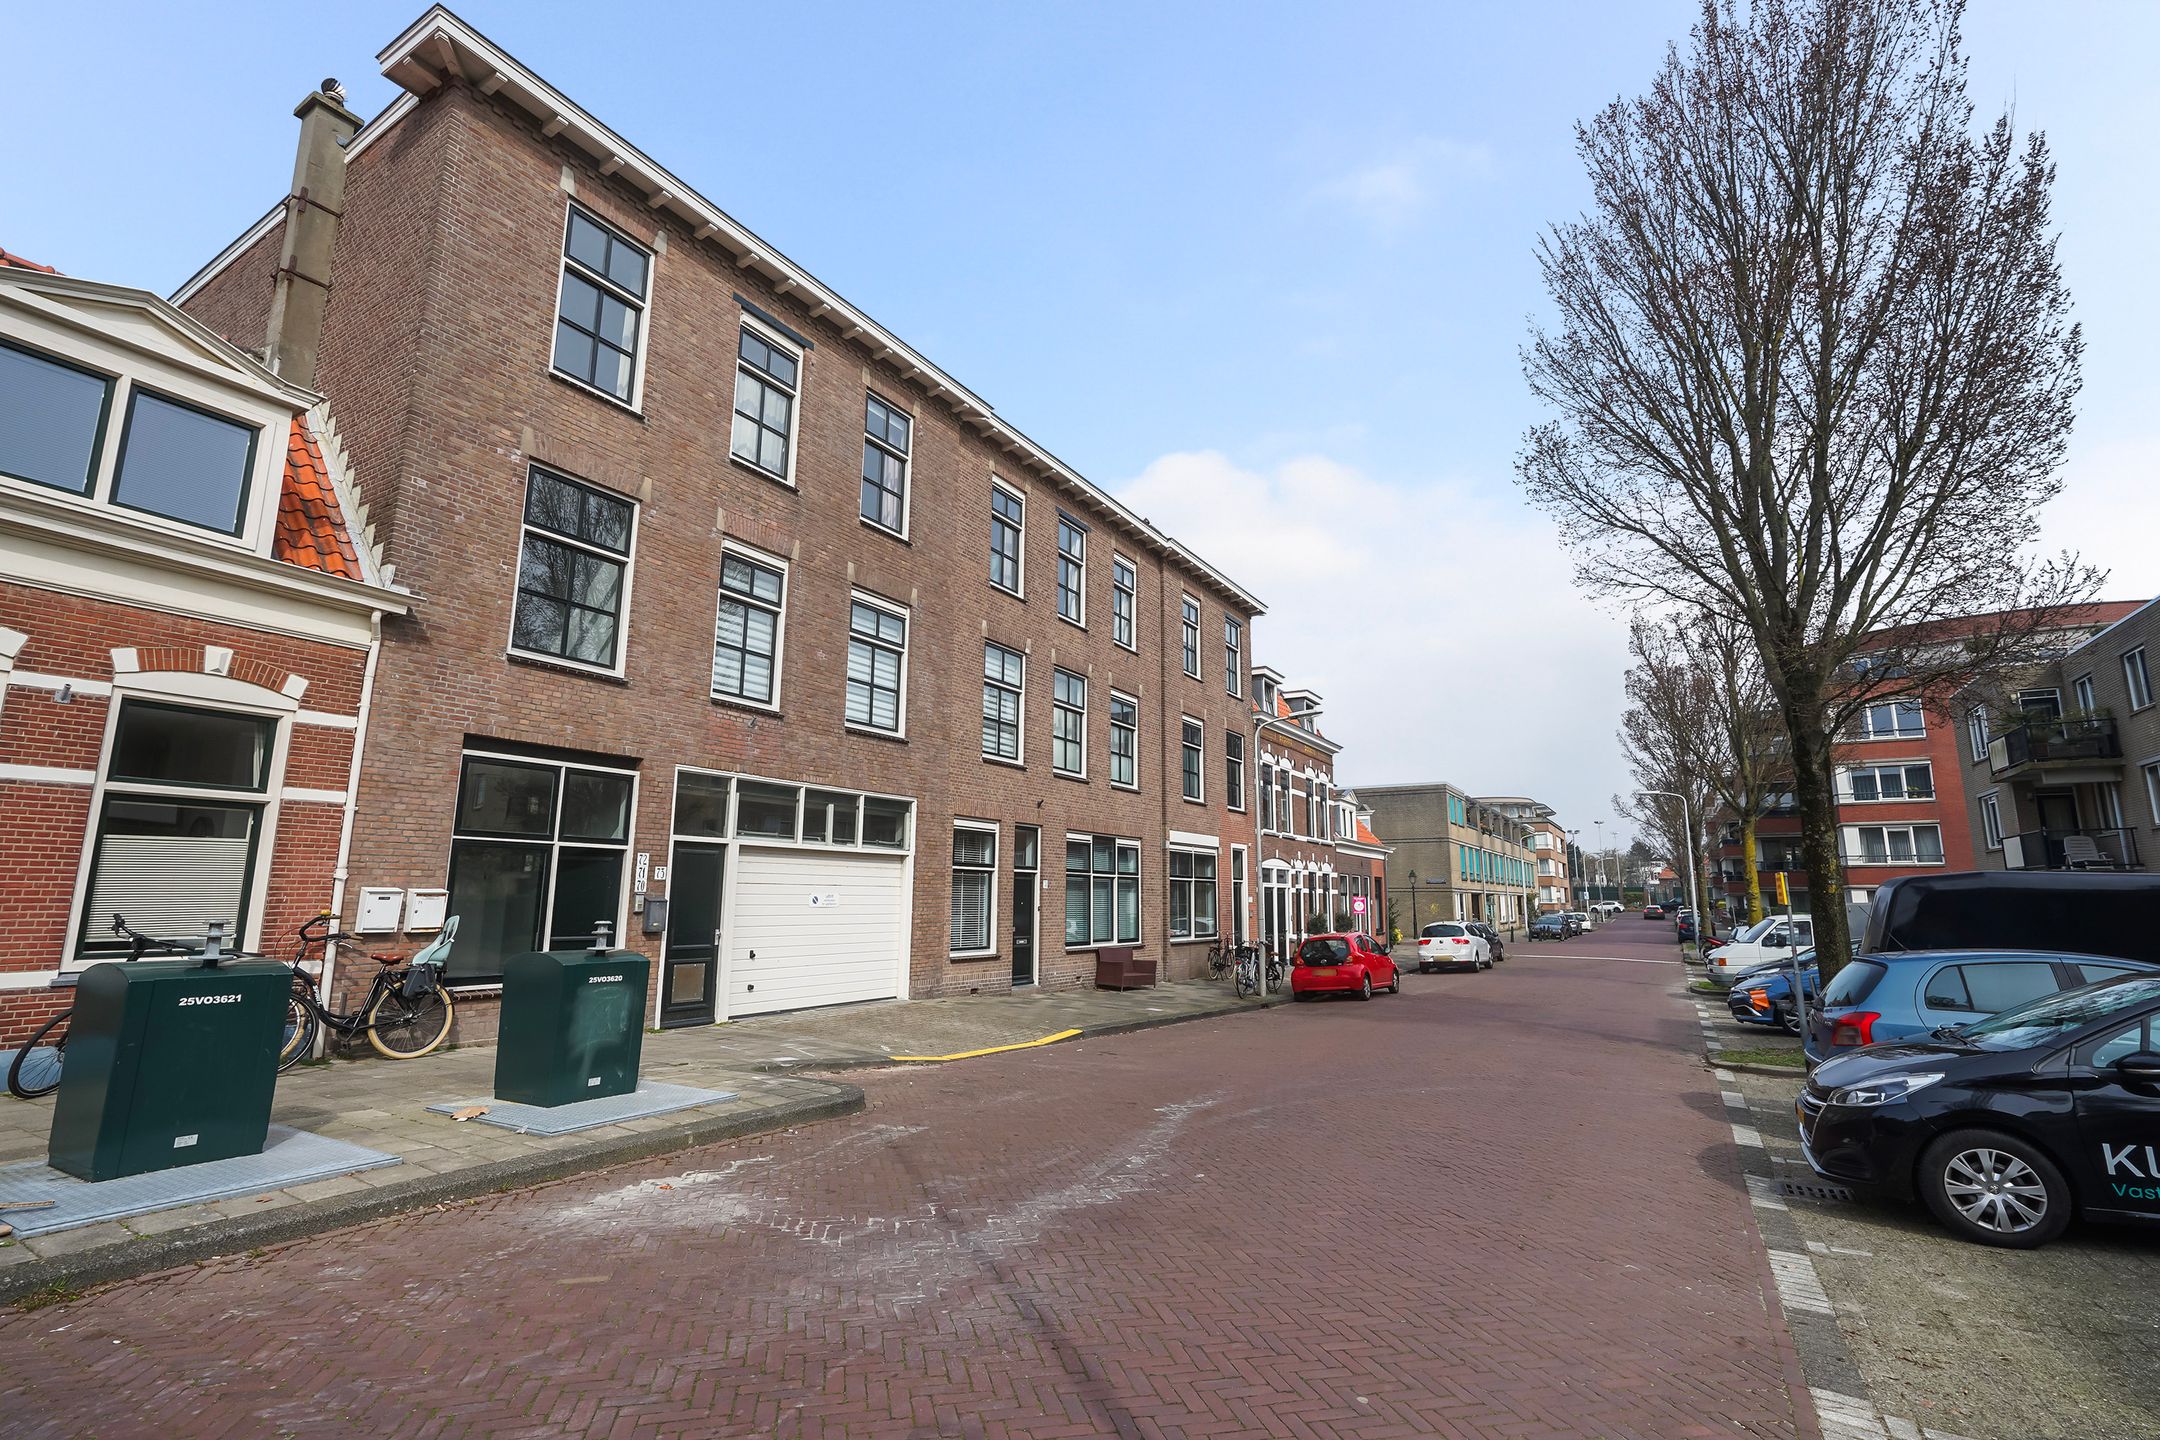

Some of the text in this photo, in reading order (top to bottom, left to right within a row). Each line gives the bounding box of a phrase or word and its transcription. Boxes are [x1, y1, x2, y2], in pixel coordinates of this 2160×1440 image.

[639, 854, 648, 866] 72
[638, 867, 646, 878] 71
[656, 867, 665, 879] 73
[636, 880, 645, 891] 70
